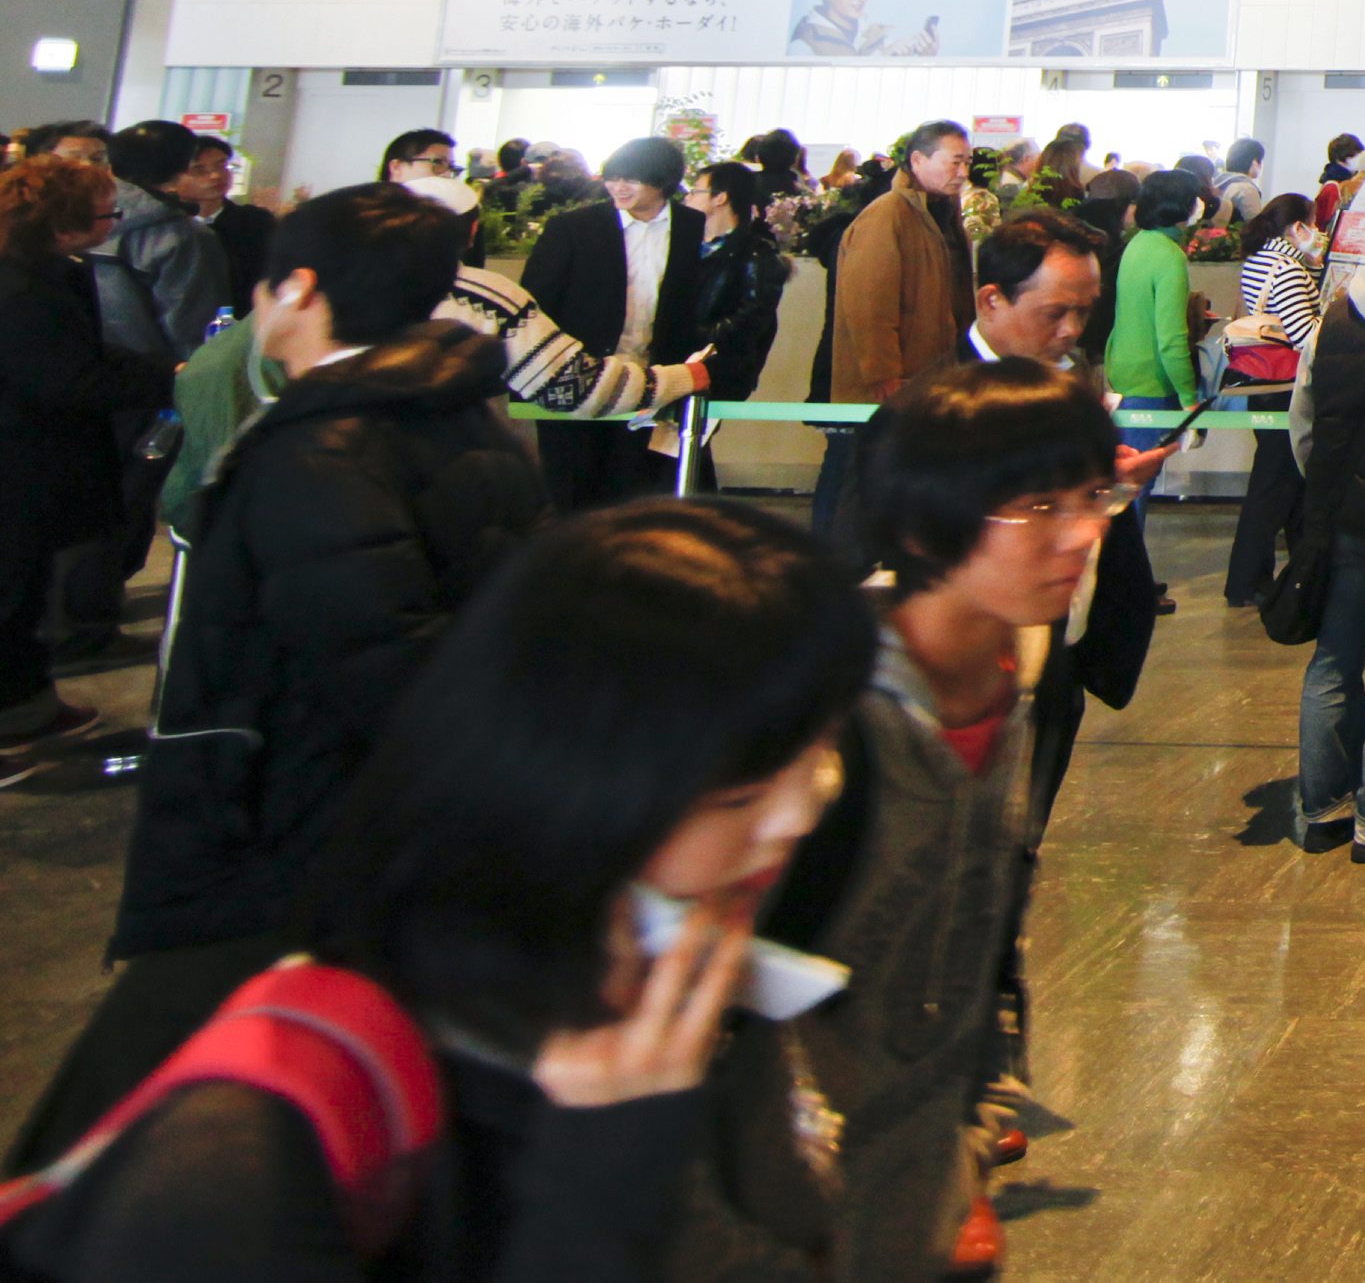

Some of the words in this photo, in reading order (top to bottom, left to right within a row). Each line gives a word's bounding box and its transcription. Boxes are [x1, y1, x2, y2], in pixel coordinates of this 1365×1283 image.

[262, 74, 285, 98] 2
[475, 73, 492, 98] 3
[1262, 77, 1272, 101] 5
